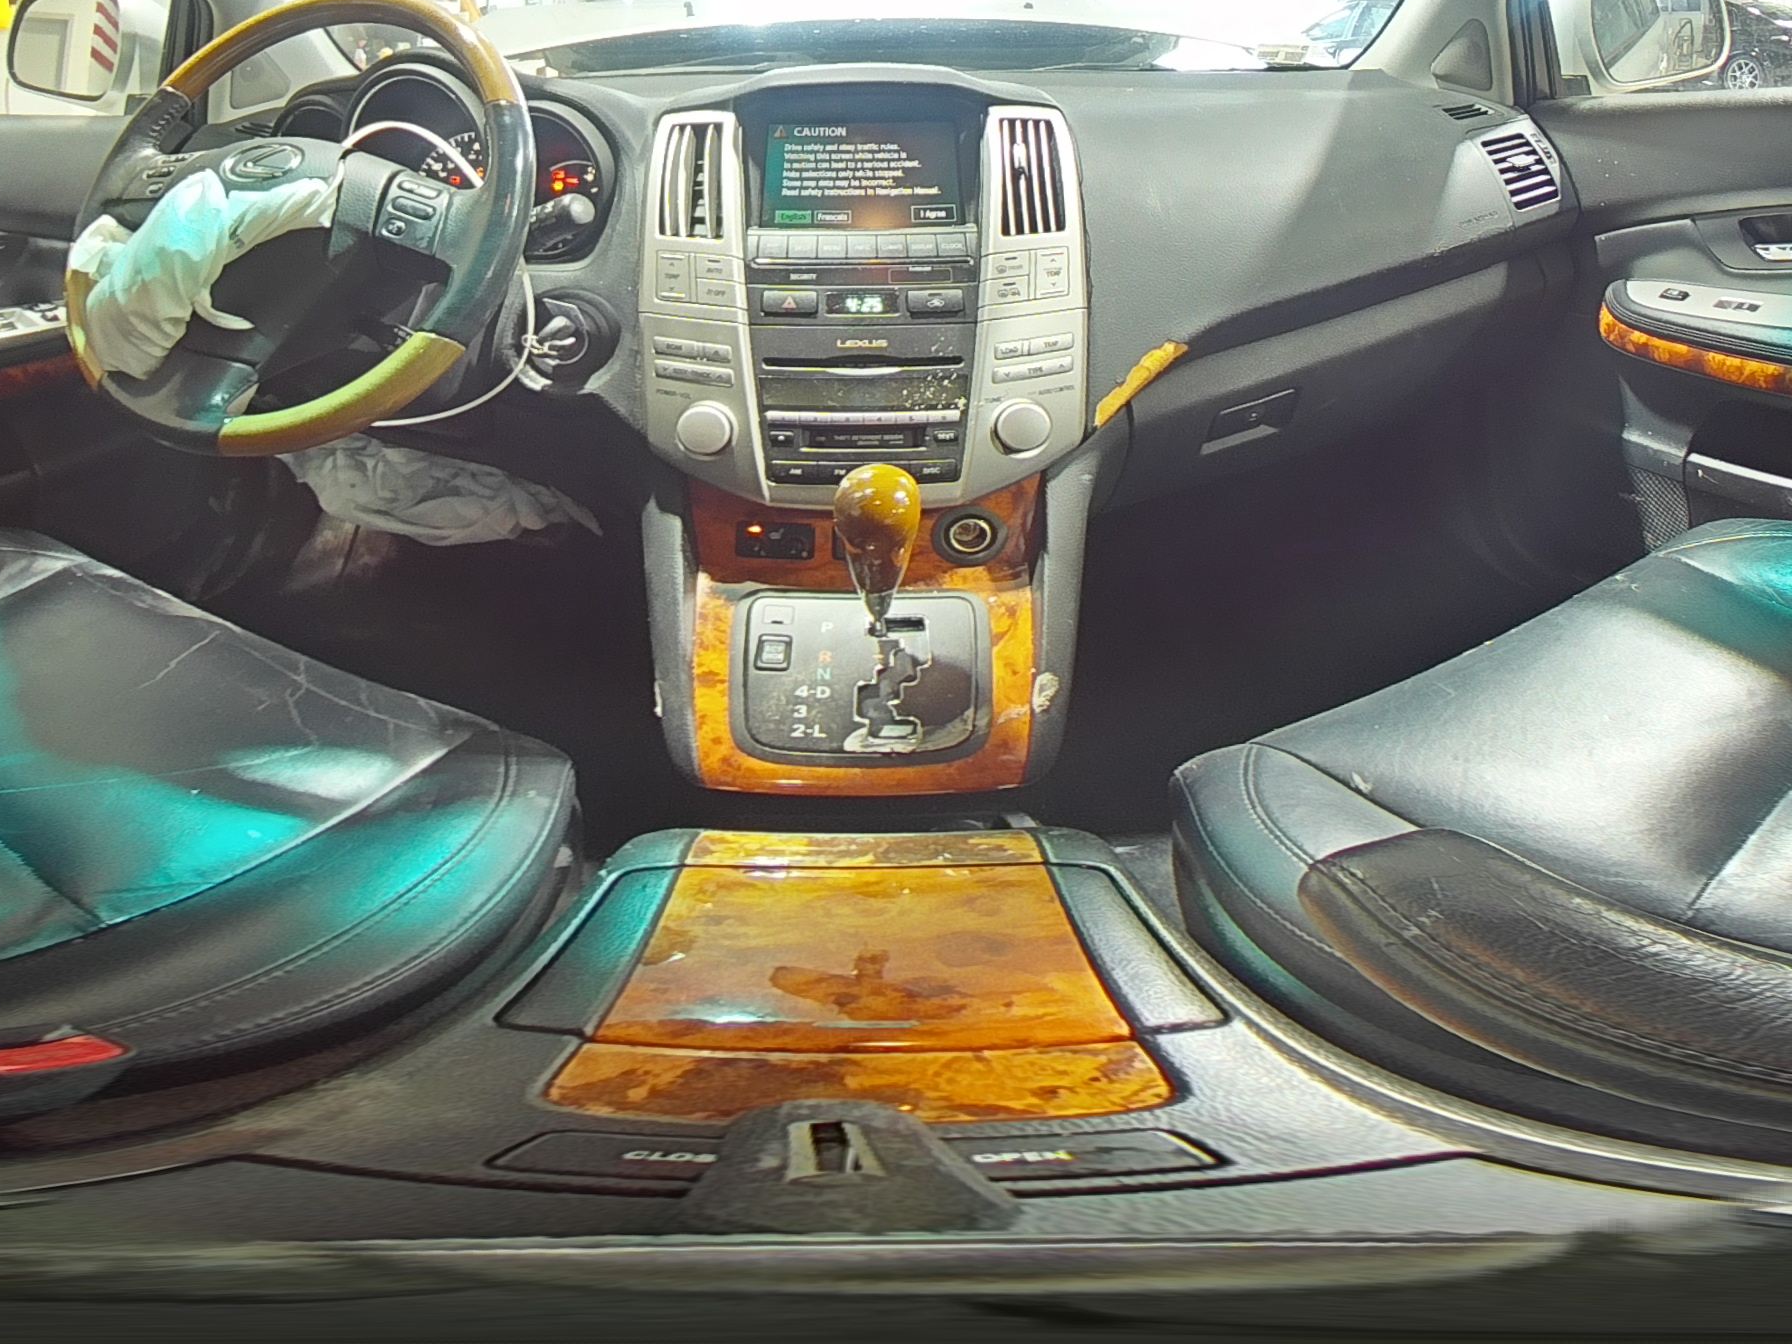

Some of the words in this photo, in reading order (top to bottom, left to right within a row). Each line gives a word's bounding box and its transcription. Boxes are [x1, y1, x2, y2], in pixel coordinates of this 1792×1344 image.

[794, 127, 847, 137] CAUTION
[780, 212, 806, 221] English
[926, 210, 946, 219] Agree
[714, 289, 726, 297] OFF
[836, 339, 888, 348] LEXUS
[1027, 366, 1043, 374] TYPE
[821, 621, 833, 633] P
[819, 650, 832, 664] R
[817, 668, 831, 680] N
[793, 685, 831, 698] 4-D
[793, 705, 807, 718] 3
[790, 724, 827, 737] 2-L
[622, 1149, 717, 1164] CLOS
[972, 1149, 1074, 1163] OPEN
